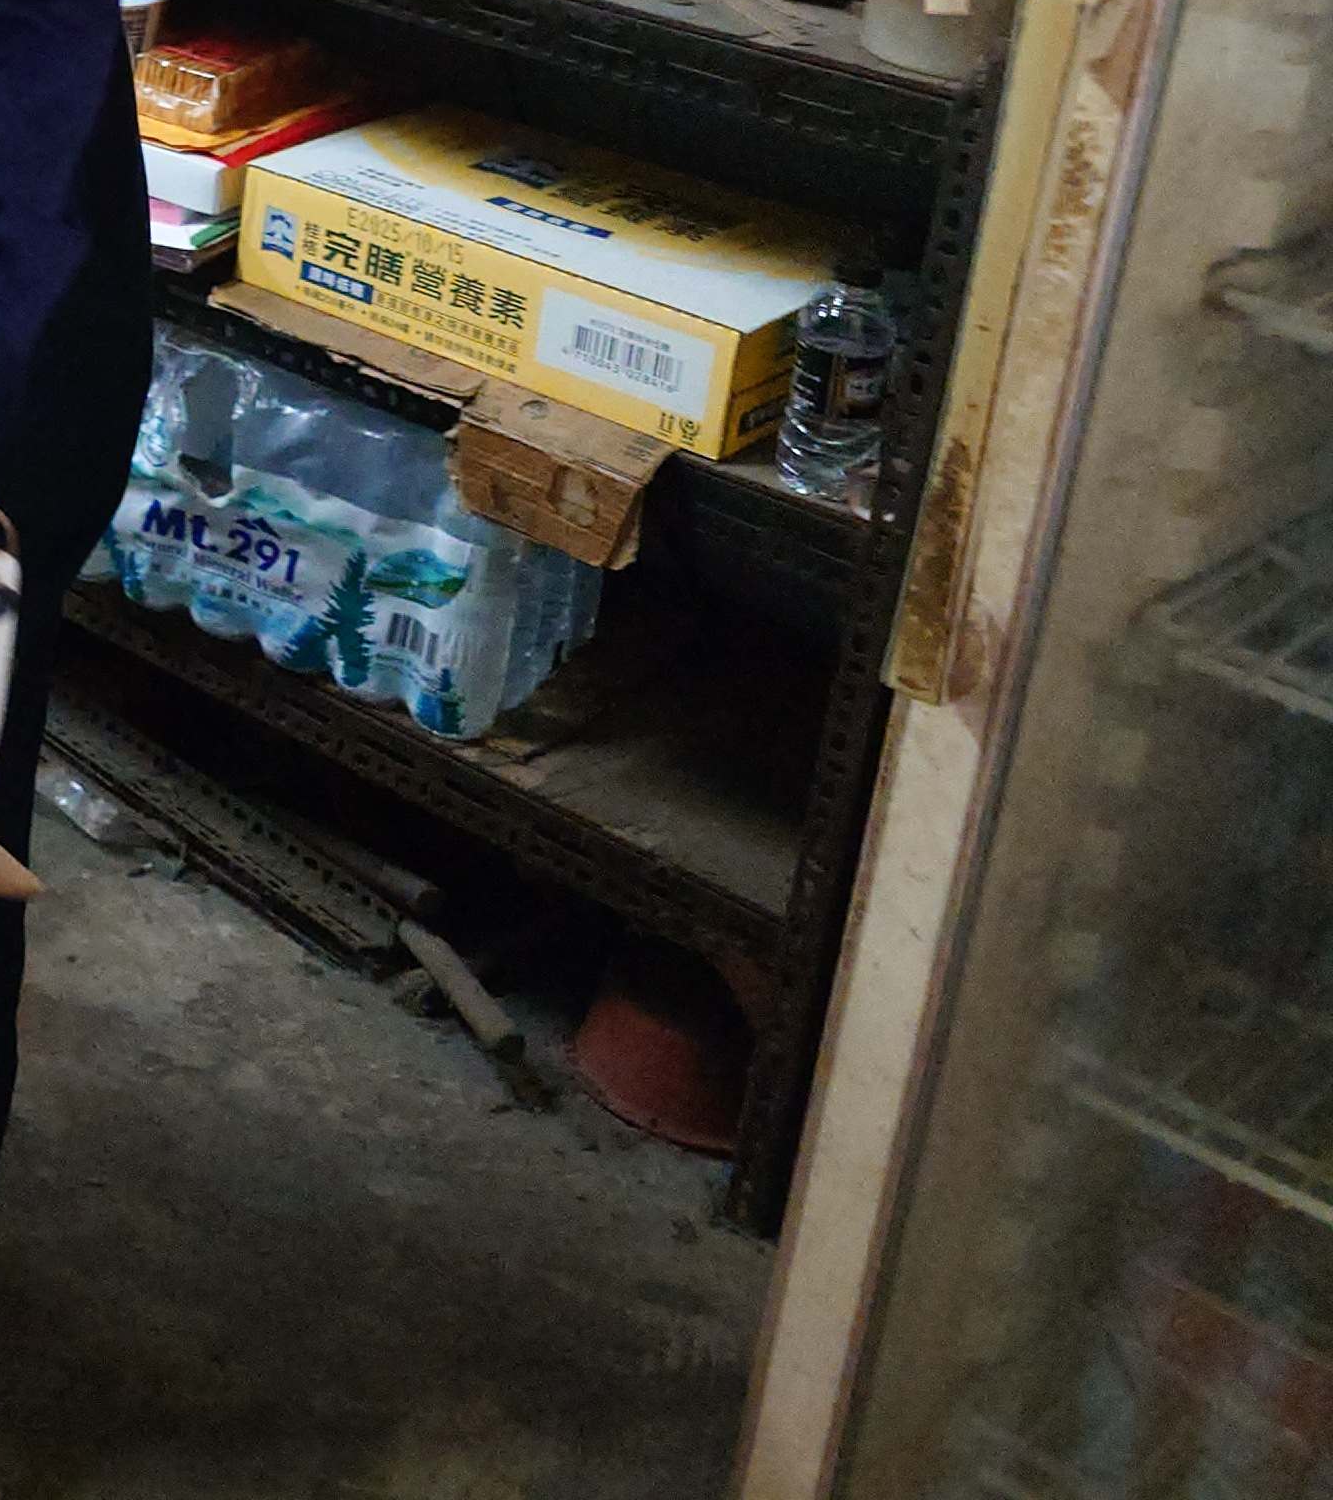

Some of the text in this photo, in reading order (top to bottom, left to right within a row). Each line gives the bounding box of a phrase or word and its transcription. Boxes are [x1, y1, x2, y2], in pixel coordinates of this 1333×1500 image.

[324, 227, 527, 330] 完膳營養素
[227, 528, 301, 583] 291
